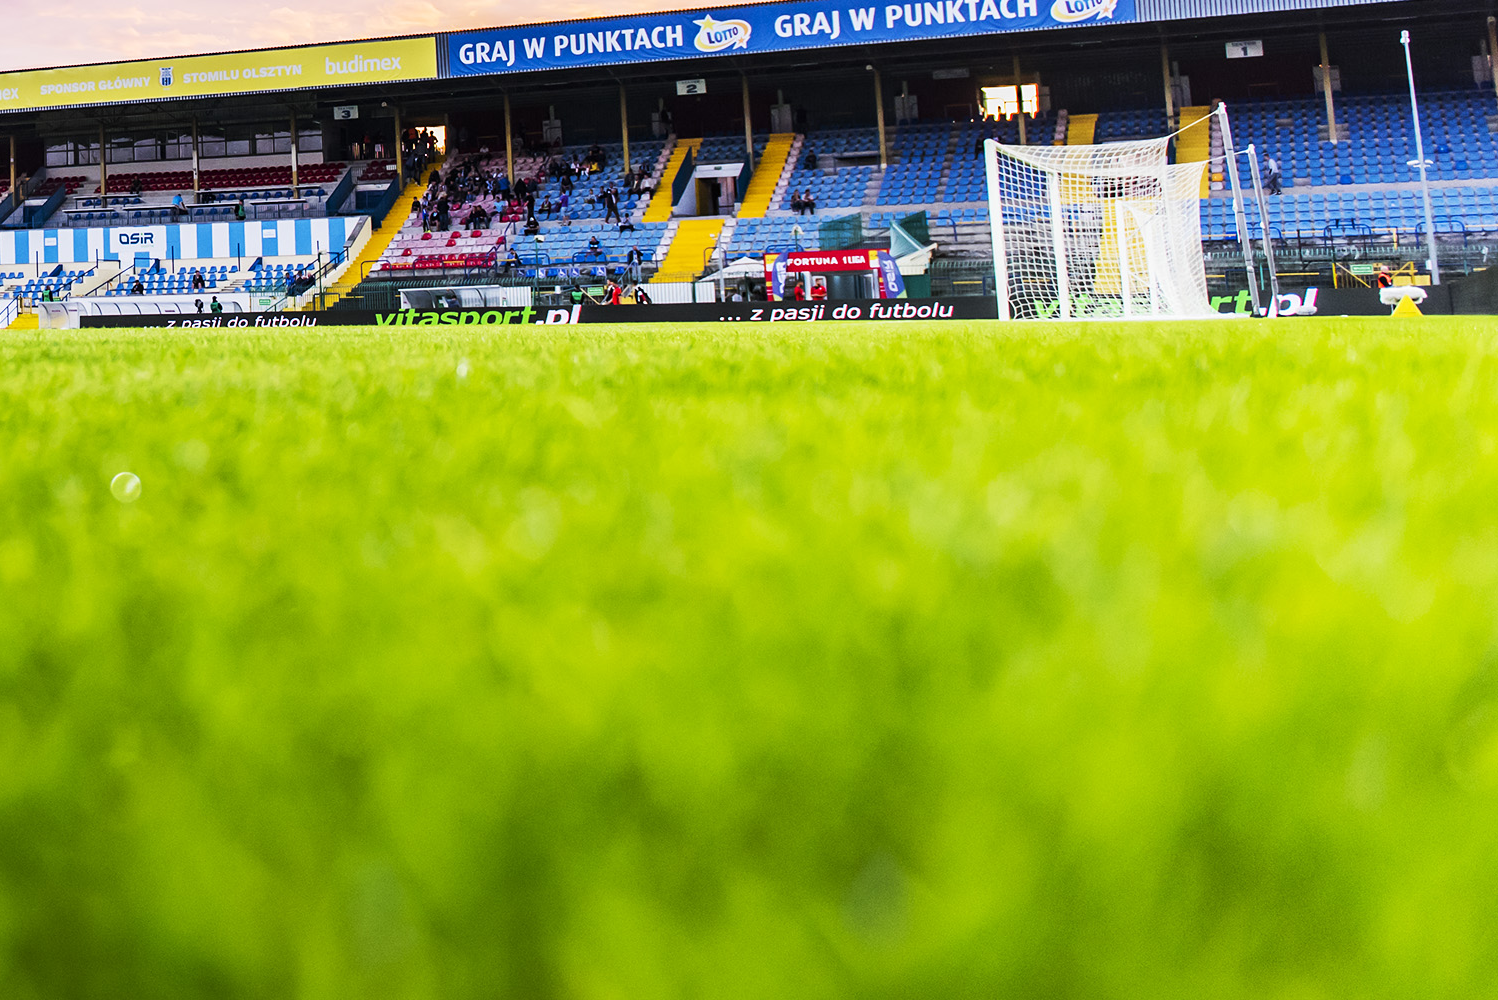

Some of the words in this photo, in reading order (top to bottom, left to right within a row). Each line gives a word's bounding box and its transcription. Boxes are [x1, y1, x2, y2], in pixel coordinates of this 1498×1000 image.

[774, 10, 841, 40] GRAJ
[847, 6, 877, 31] W
[707, 26, 739, 44] LOTTO
[459, 39, 515, 66] GRAJ
[523, 36, 546, 58] W
[554, 24, 684, 57] PUNKTACH
[1241, 46, 1248, 56] 1
[325, 56, 402, 75] budimex
[40, 81, 96, 95] SPONSOR
[98, 76, 151, 91] GŁÓWNY
[183, 69, 239, 84] STOMILU
[245, 64, 302, 80] OLSZTYN
[686, 84, 698, 94] 2
[341, 110, 351, 119] 3
[786, 256, 839, 267] FORTUNA
[375, 305, 582, 325] vitasport.pl
[750, 308, 764, 321] z
[770, 304, 825, 322] pasji
[832, 303, 861, 319] do
[869, 302, 954, 319] futbolu
[166, 320, 177, 329] z
[227, 316, 249, 328] do
[254, 314, 317, 328] futbolu
